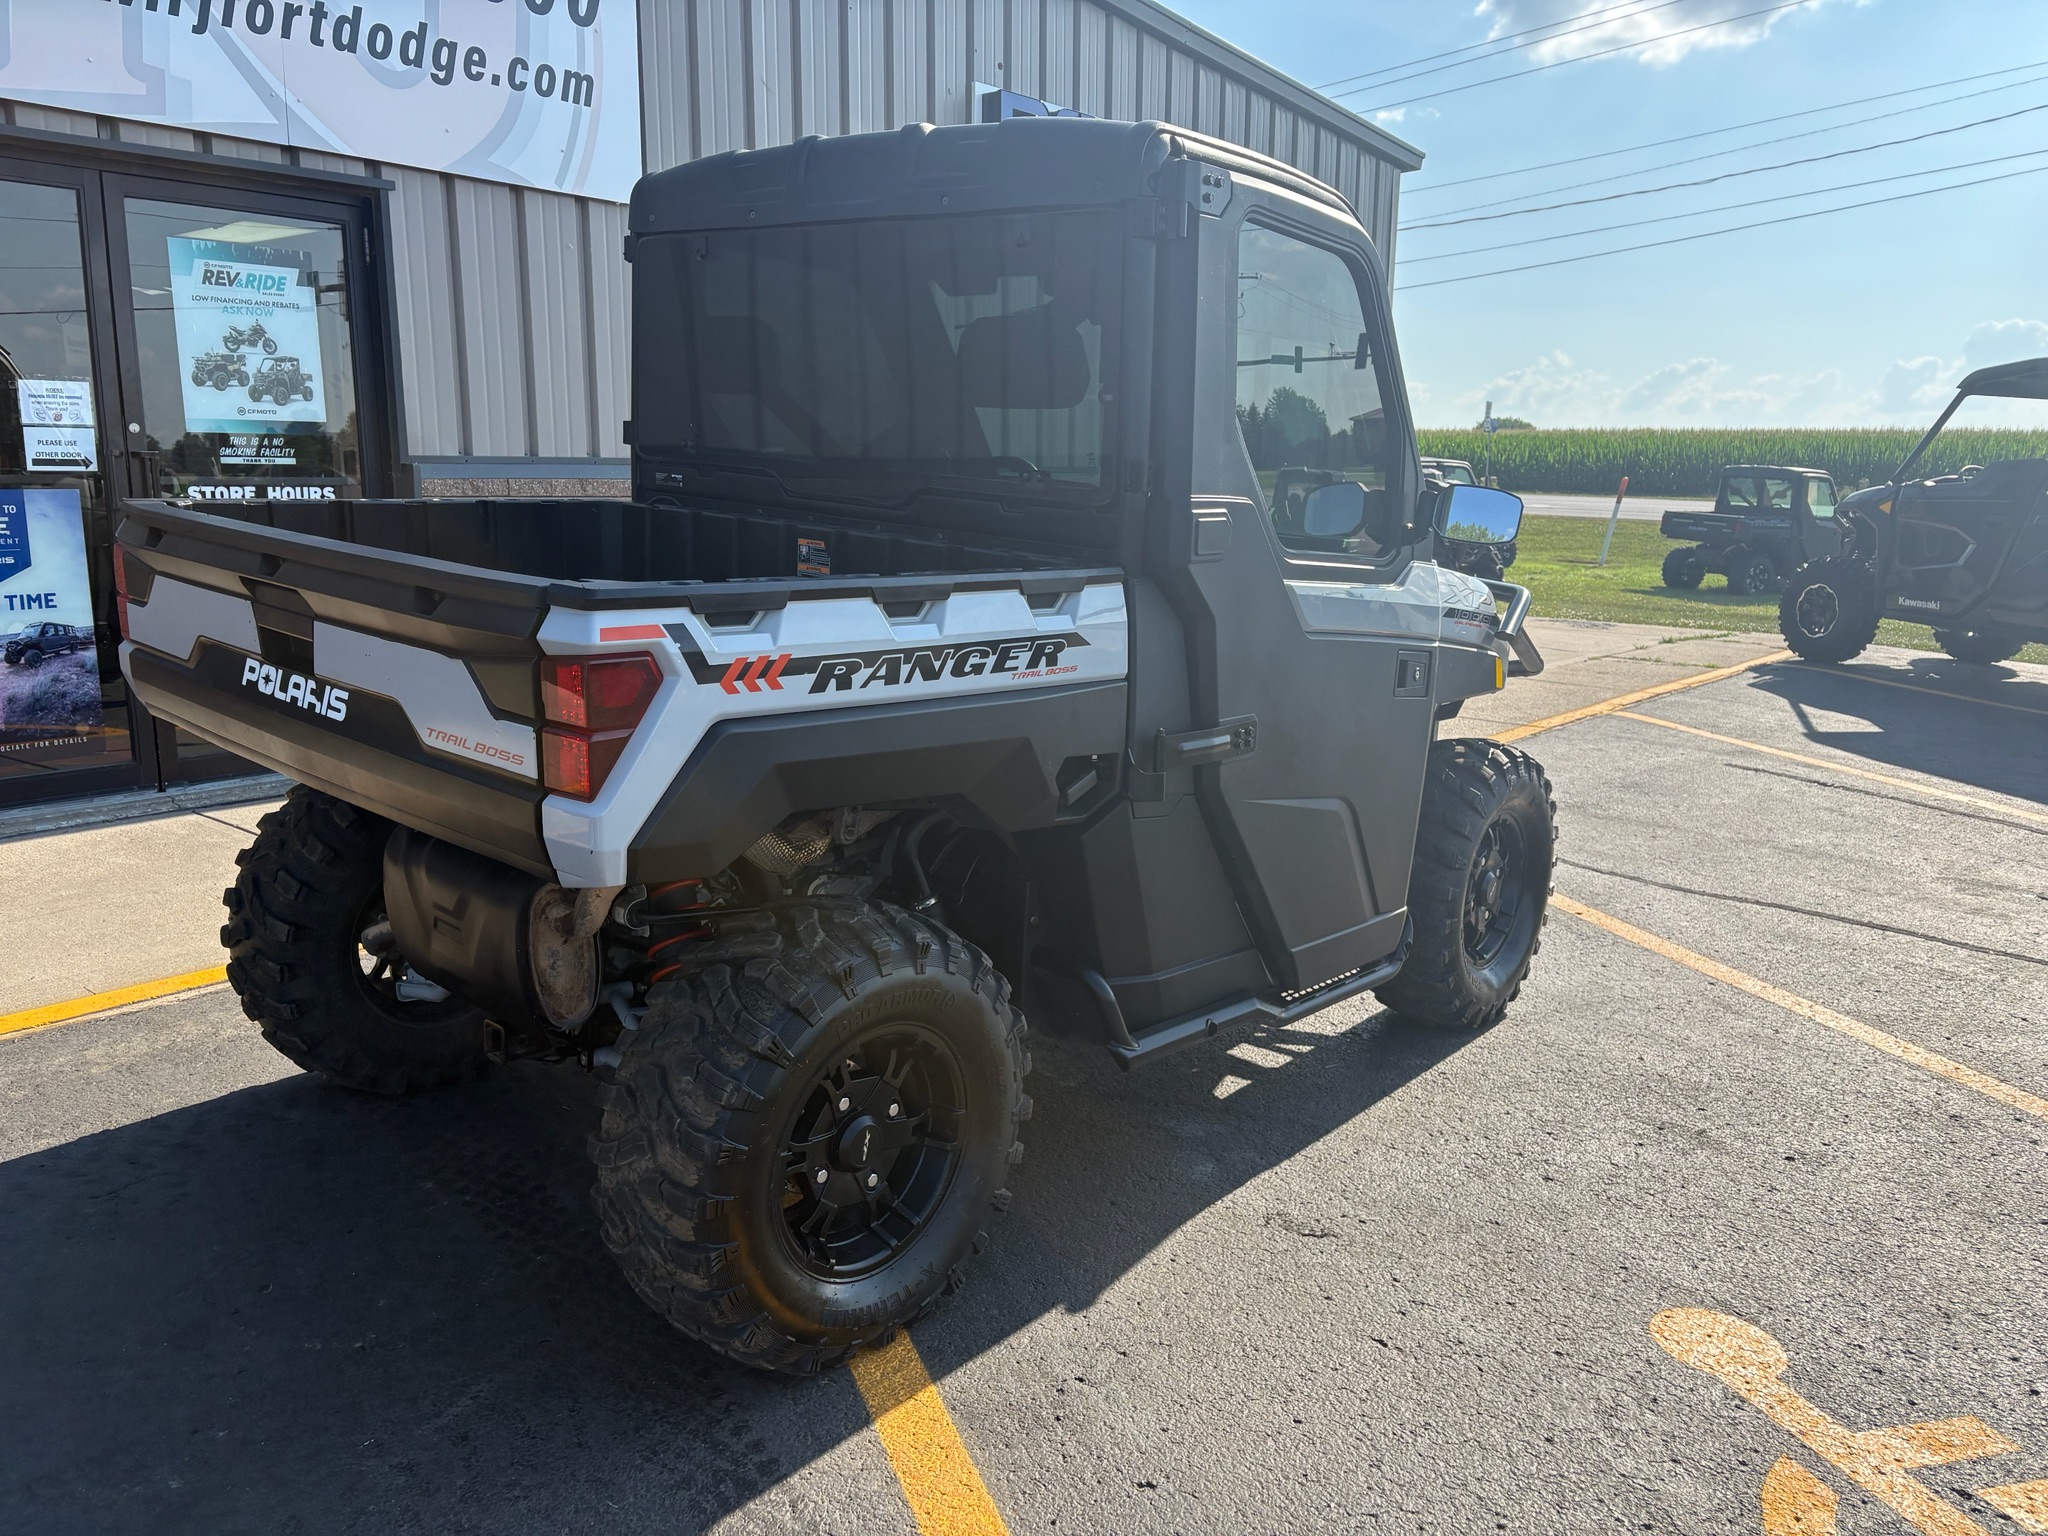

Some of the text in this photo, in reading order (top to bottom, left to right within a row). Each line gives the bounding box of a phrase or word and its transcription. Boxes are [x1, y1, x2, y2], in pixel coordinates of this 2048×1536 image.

[210, 296, 252, 305] FINANCING
[272, 302, 300, 310] REBATES
[222, 305, 274, 317] ASK NOW
[230, 436, 284, 446] THIS IS A NO
[220, 447, 295, 456] SMOKING FACILITY
[188, 486, 336, 500] STORE HOURS
[2, 505, 16, 514] TO
[4, 592, 58, 610] TIME
[1442, 584, 1492, 609] XP
[1898, 596, 1940, 610] Kawasaki
[1454, 608, 1491, 624] 1000
[808, 639, 1068, 694] RANGER
[1012, 665, 1078, 680] TRAIL BOSS
[242, 658, 349, 722] POLARIS
[0, 736, 88, 752] OCIATE FOR DETAILS
[426, 728, 524, 766] TRAIL BOSS
